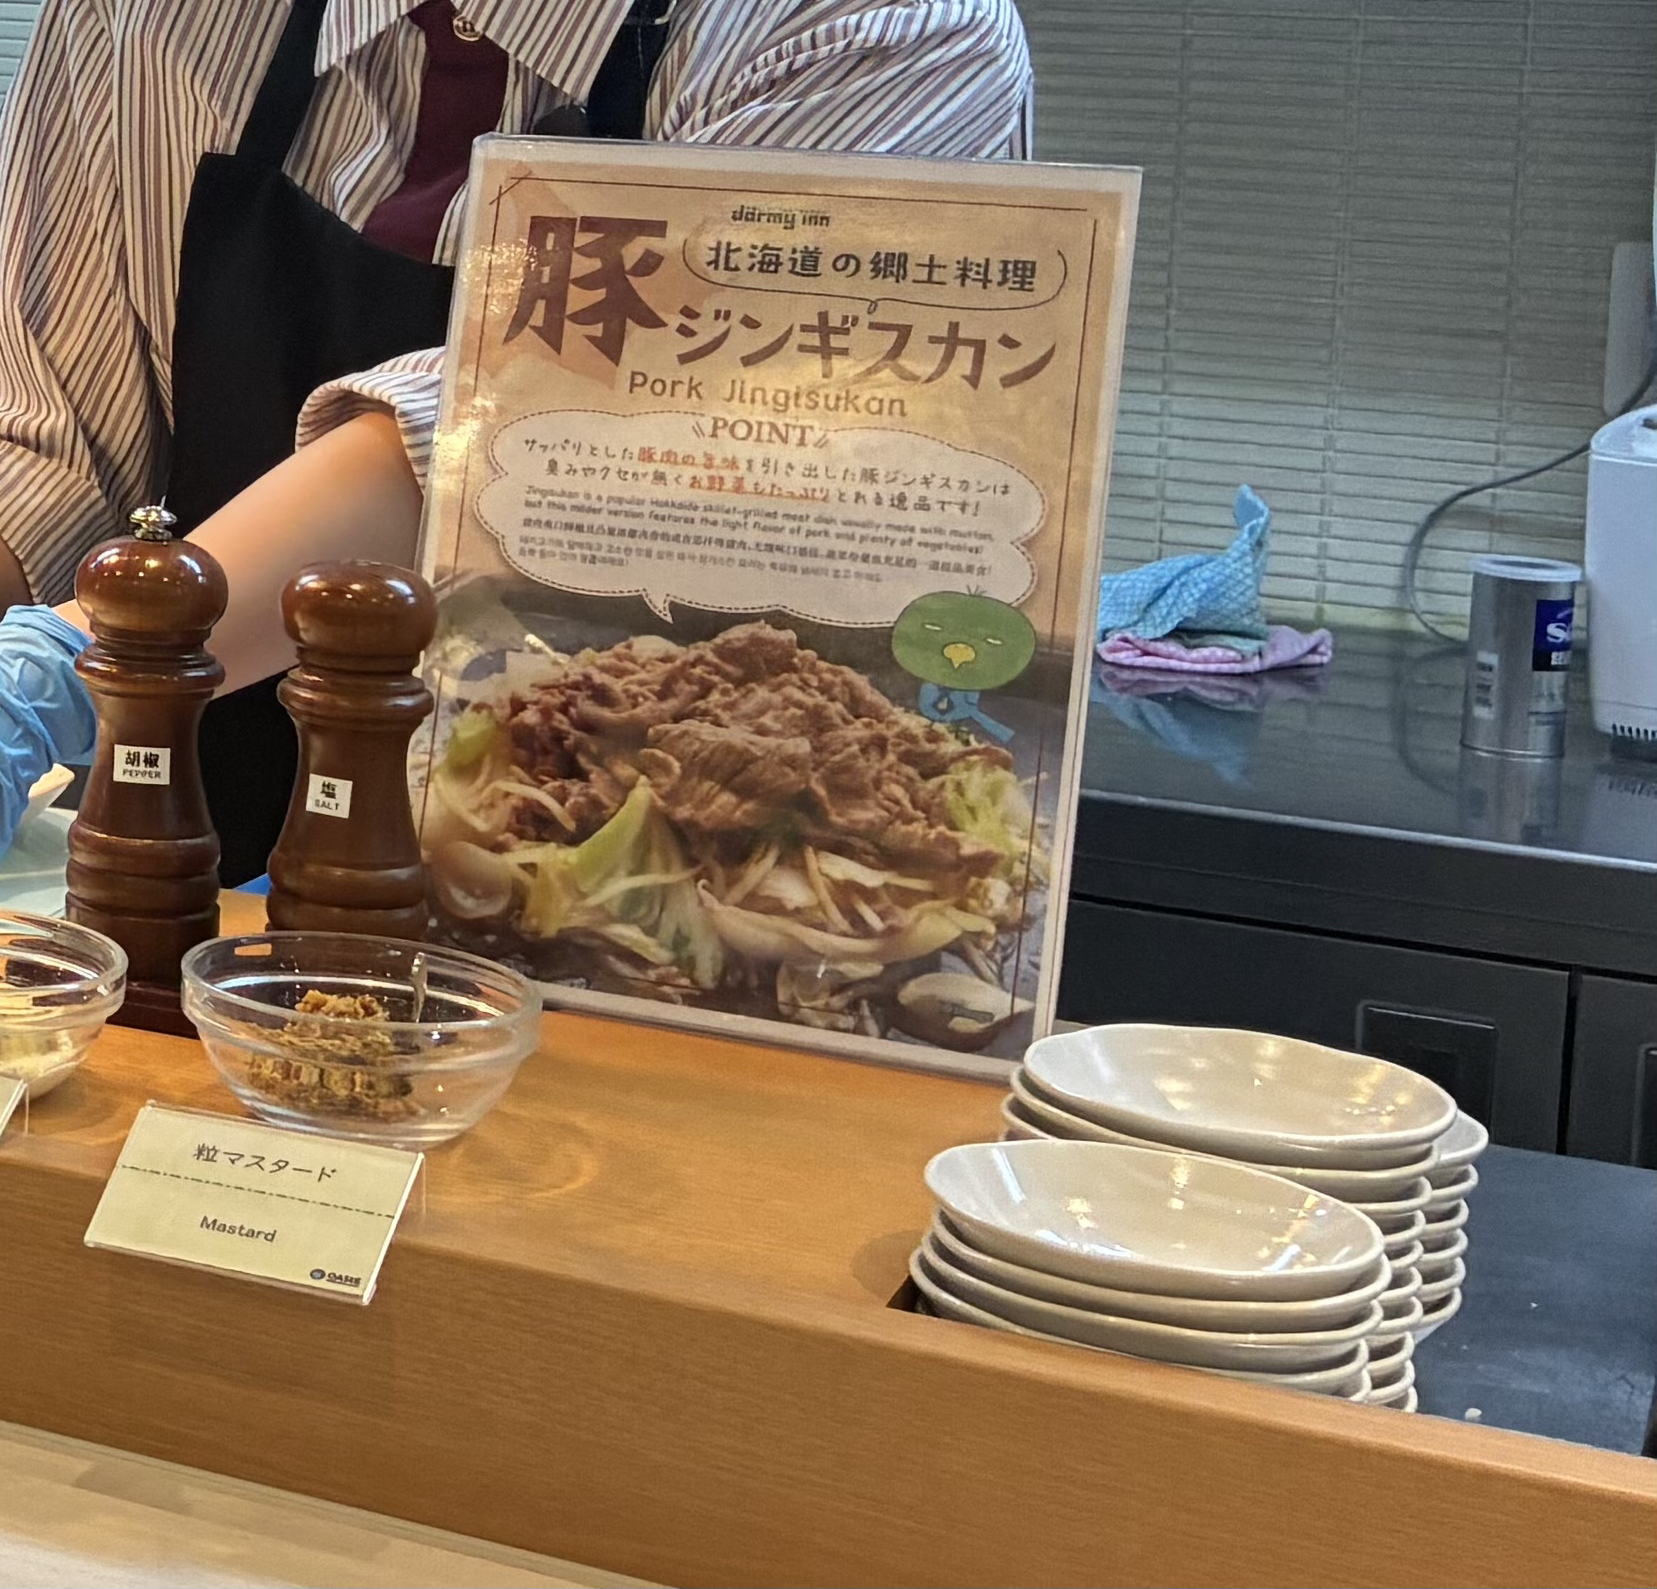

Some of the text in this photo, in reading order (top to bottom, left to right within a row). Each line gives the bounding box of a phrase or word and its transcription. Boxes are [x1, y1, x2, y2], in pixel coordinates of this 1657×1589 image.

[800, 207, 831, 228] inn
[705, 240, 1038, 293] 北海道の郷土料理
[502, 215, 1058, 391] 豚 ジンギスカン
[628, 370, 908, 421] Pork Jingisukan
[709, 416, 815, 447] POINT
[122, 768, 162, 779] PEPPER
[125, 750, 160, 769] 胡椒
[314, 798, 341, 811] SALT
[193, 1143, 338, 1183] 粒マスタード
[199, 1214, 278, 1243] Mastard
